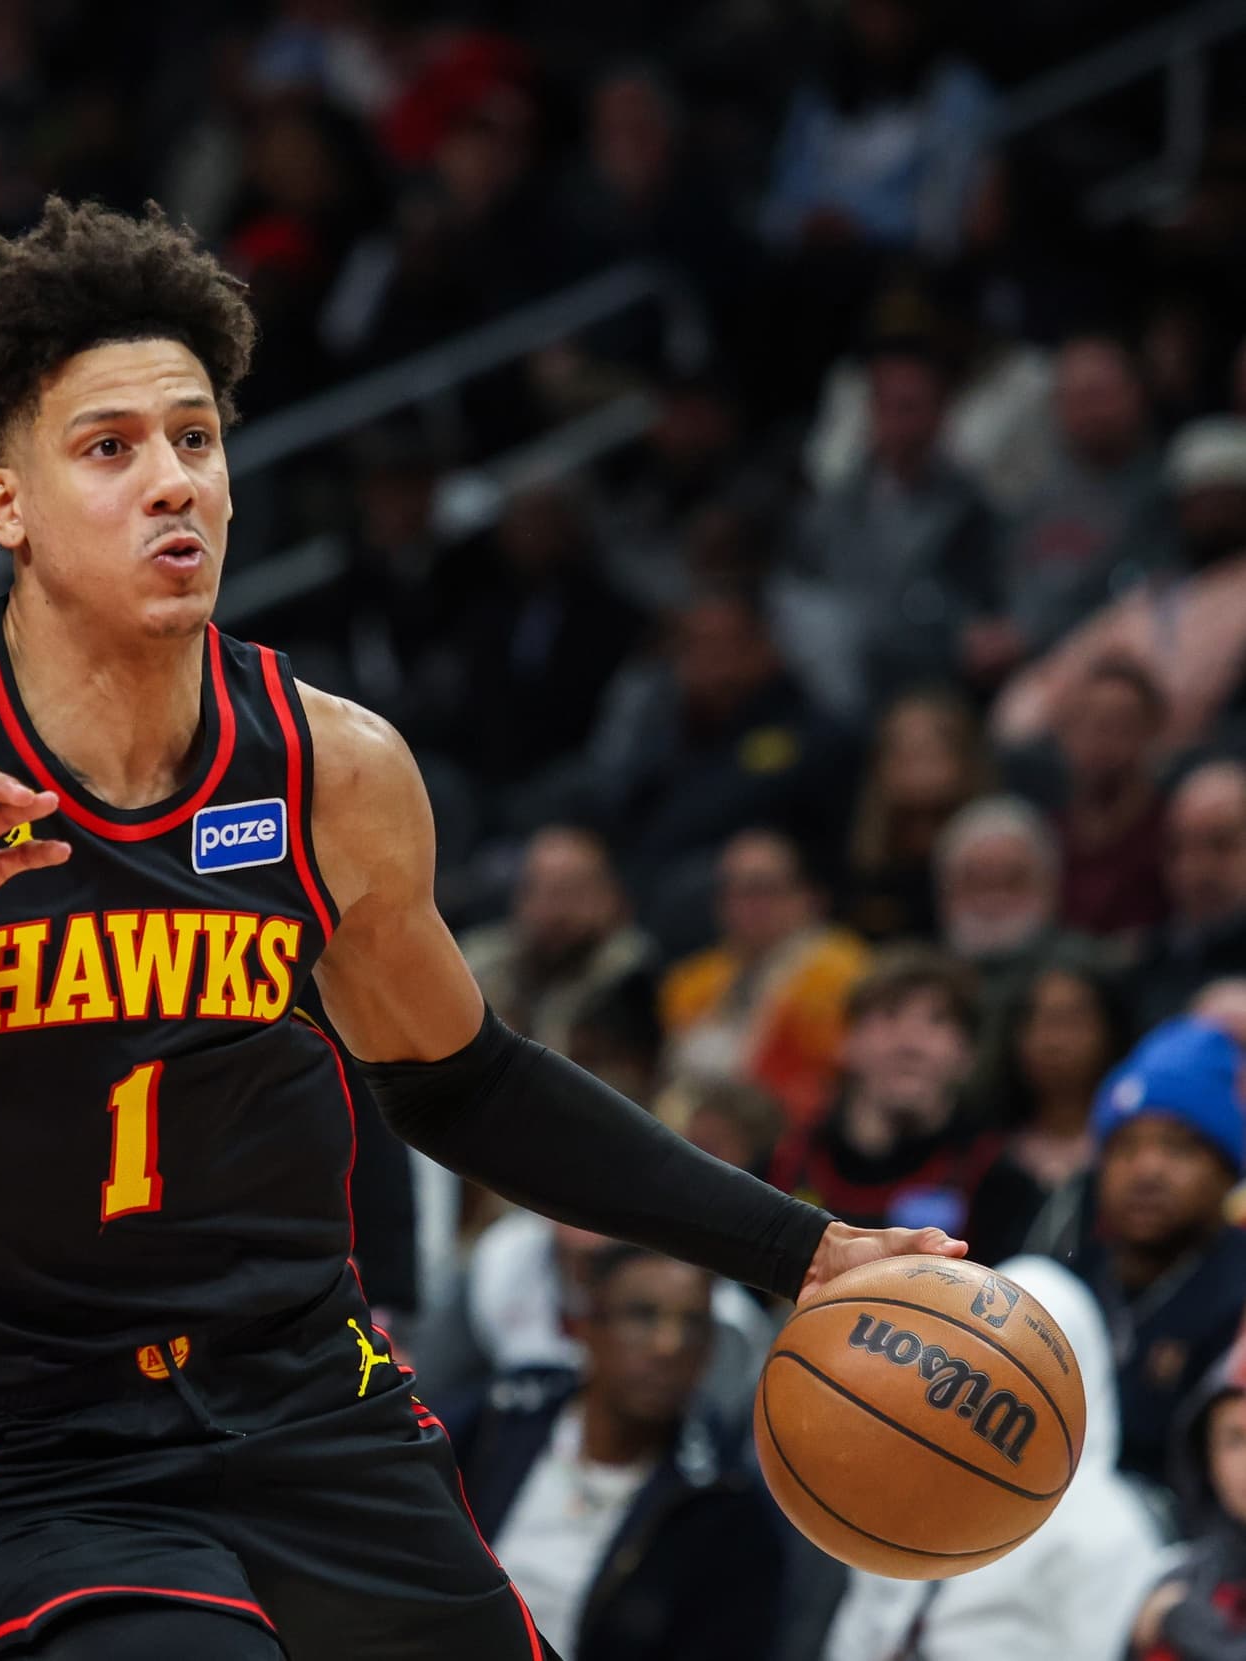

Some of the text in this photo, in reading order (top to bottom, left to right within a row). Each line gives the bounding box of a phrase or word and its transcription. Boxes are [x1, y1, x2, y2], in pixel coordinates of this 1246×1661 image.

[200, 817, 277, 857] paze
[100, 1059, 164, 1223] 1
[848, 1312, 1038, 1466] Wilson
